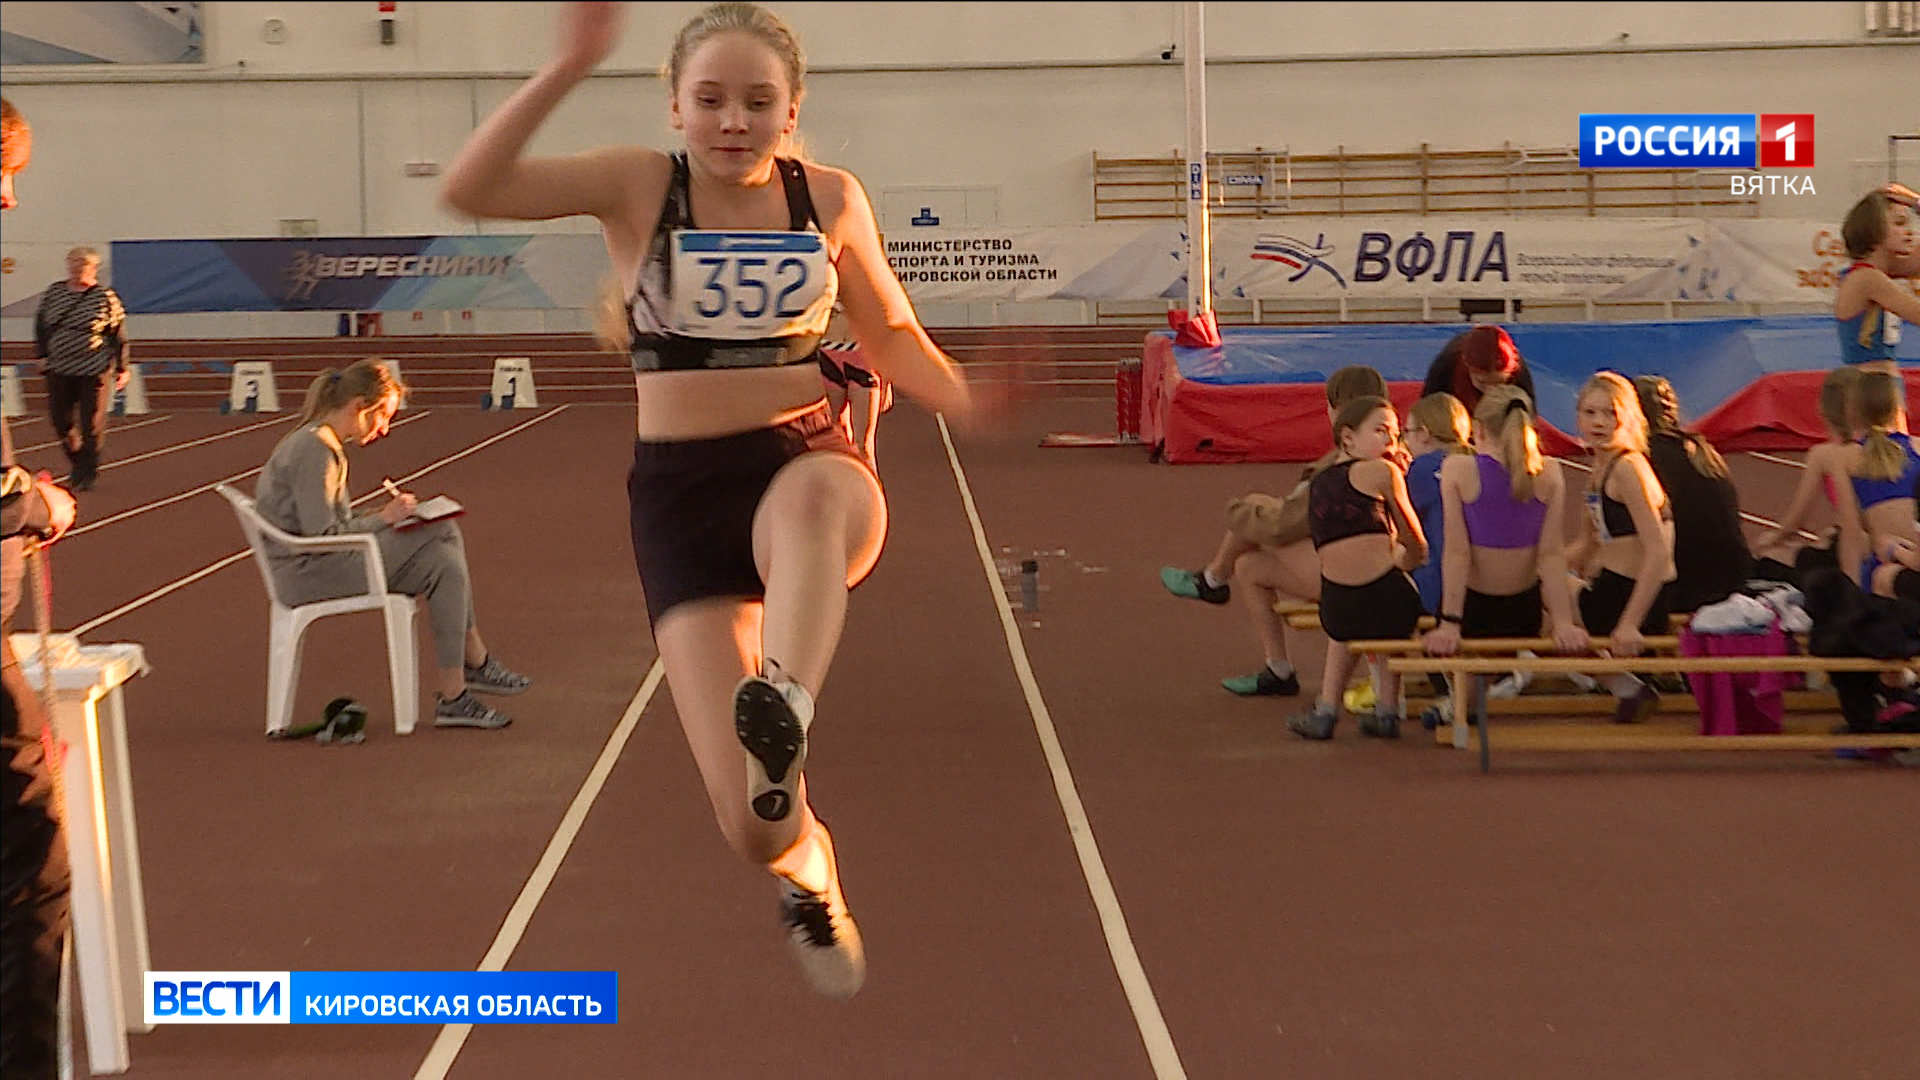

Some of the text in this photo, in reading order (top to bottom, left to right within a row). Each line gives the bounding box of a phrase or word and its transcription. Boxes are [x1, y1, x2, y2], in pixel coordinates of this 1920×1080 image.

[887, 239, 1012, 253] МИНИСТЕРСТВО
[315, 255, 510, 278] ВЕРЕСНИКИ
[887, 254, 1040, 269] СПОРТА И ТУРИЗМА
[1353, 231, 1511, 283] ВФЛА
[894, 268, 1058, 283] ИРОВСКОЙ ОБЛАСТИ
[695, 257, 810, 319] 352
